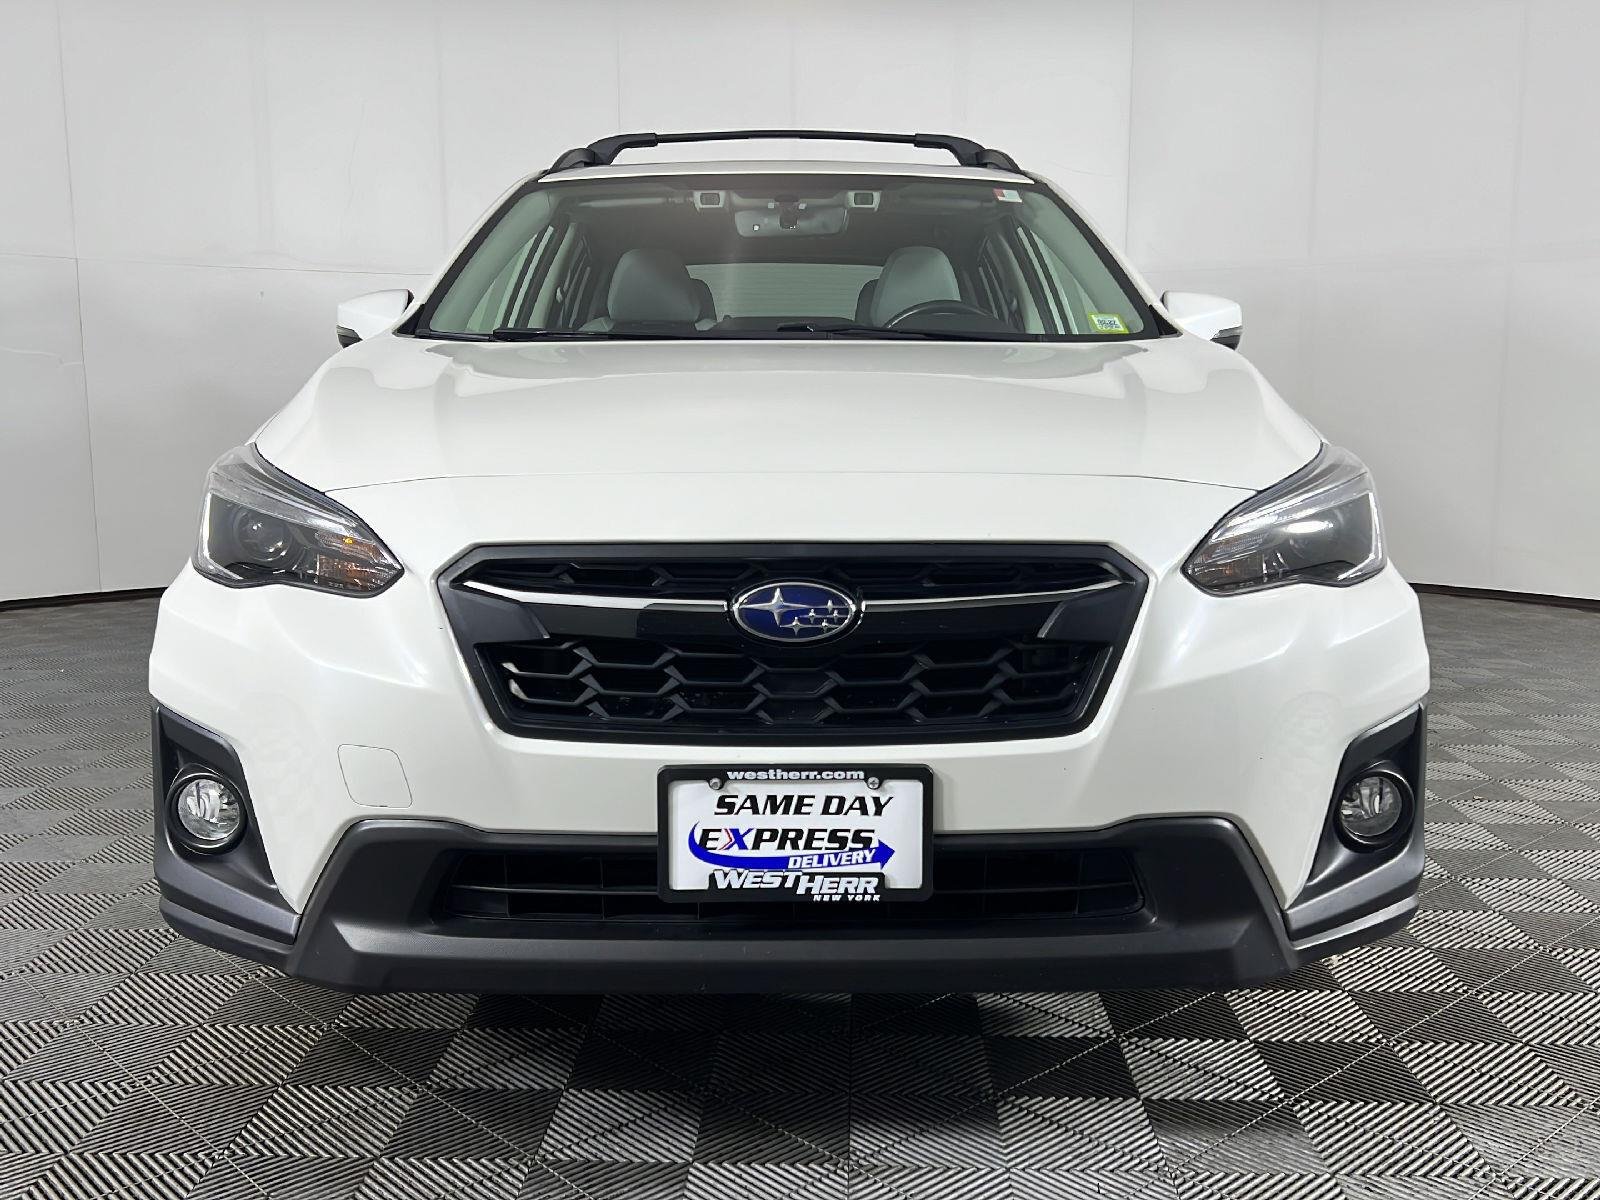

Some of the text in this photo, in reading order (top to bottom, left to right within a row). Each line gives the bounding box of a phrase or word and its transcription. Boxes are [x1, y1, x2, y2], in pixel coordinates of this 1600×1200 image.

[727, 769, 864, 780] westherr.com
[714, 794, 893, 816] SAME DAY
[699, 828, 875, 850] EXPRESS
[788, 850, 875, 869] DELIVERY
